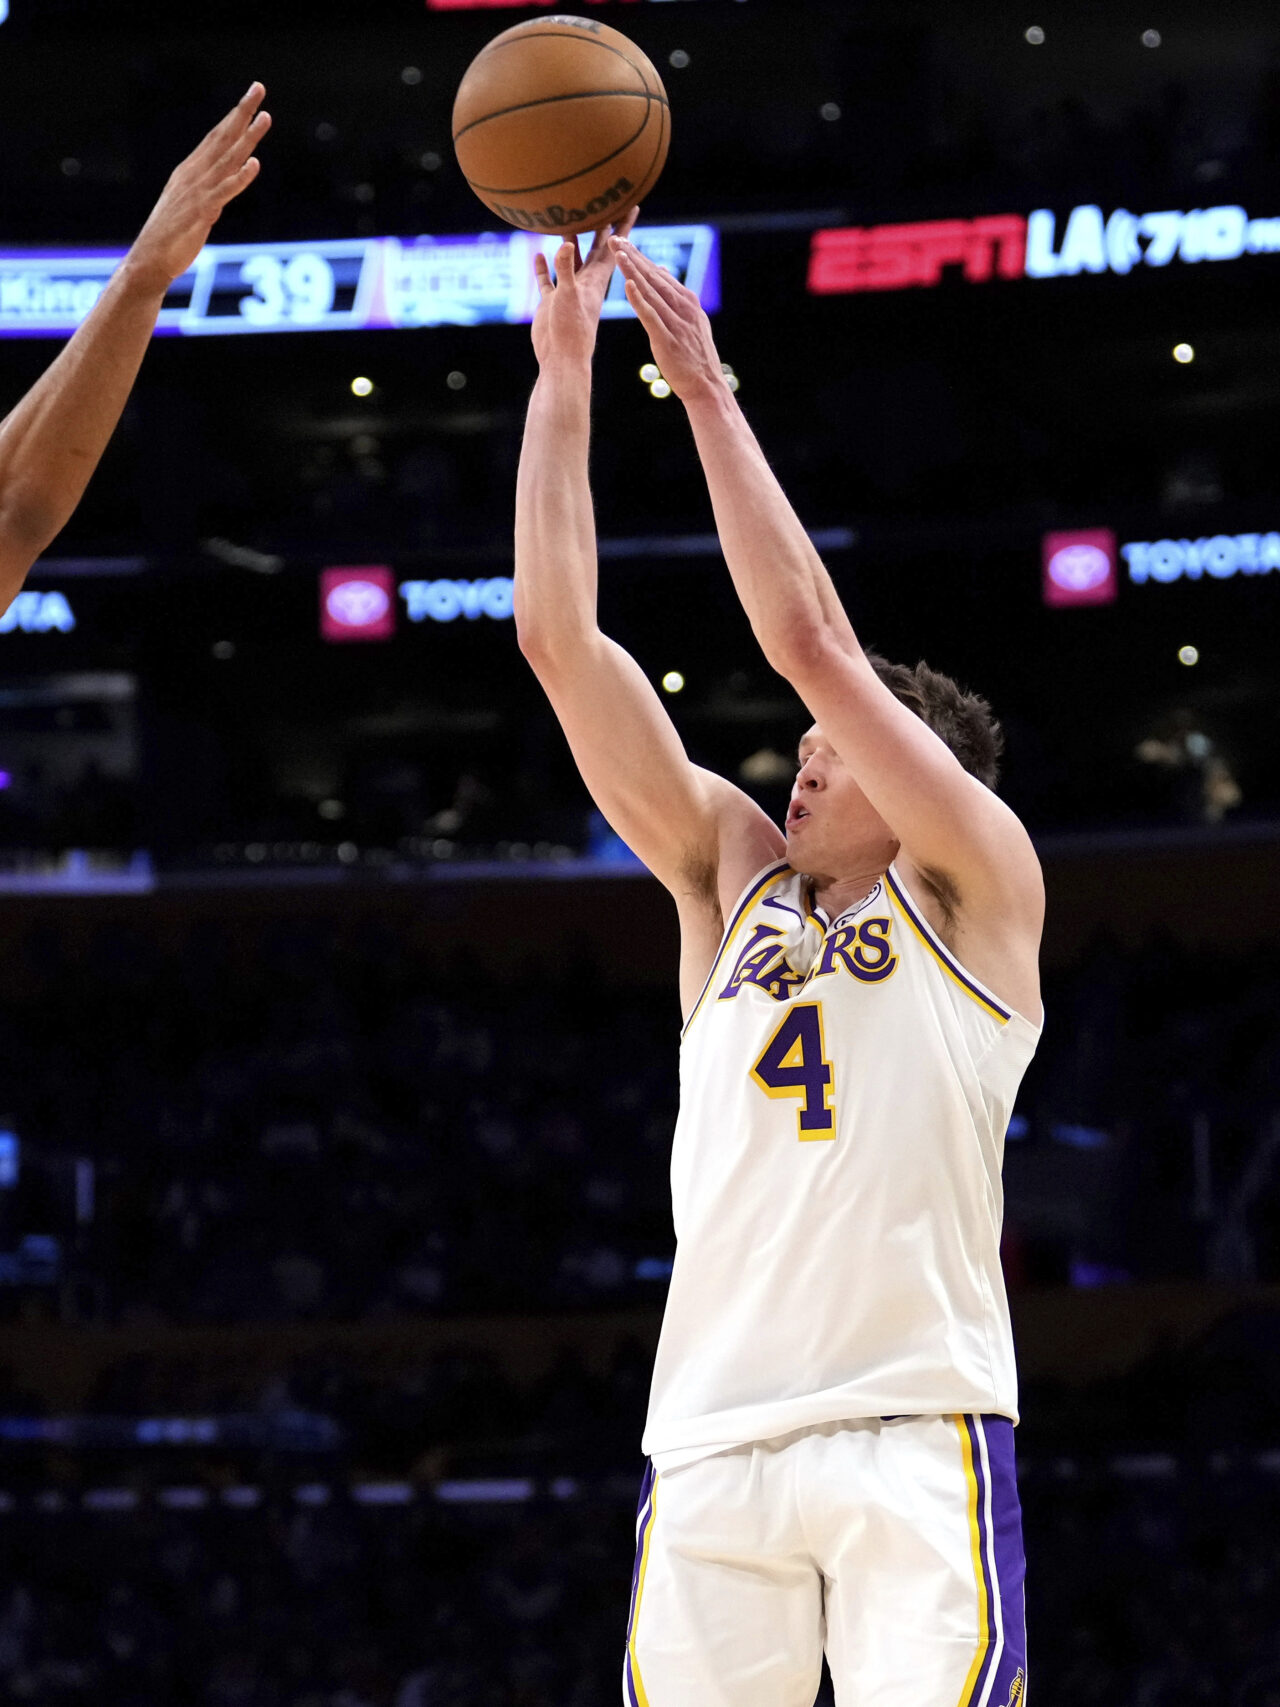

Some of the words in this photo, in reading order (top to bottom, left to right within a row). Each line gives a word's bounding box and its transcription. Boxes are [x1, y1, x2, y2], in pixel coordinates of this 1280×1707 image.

[492, 177, 634, 229] Wilson
[239, 252, 335, 325] 39
[807, 213, 1026, 295] ESPN
[717, 916, 900, 1001] LAKRS
[748, 1001, 836, 1142] 4
